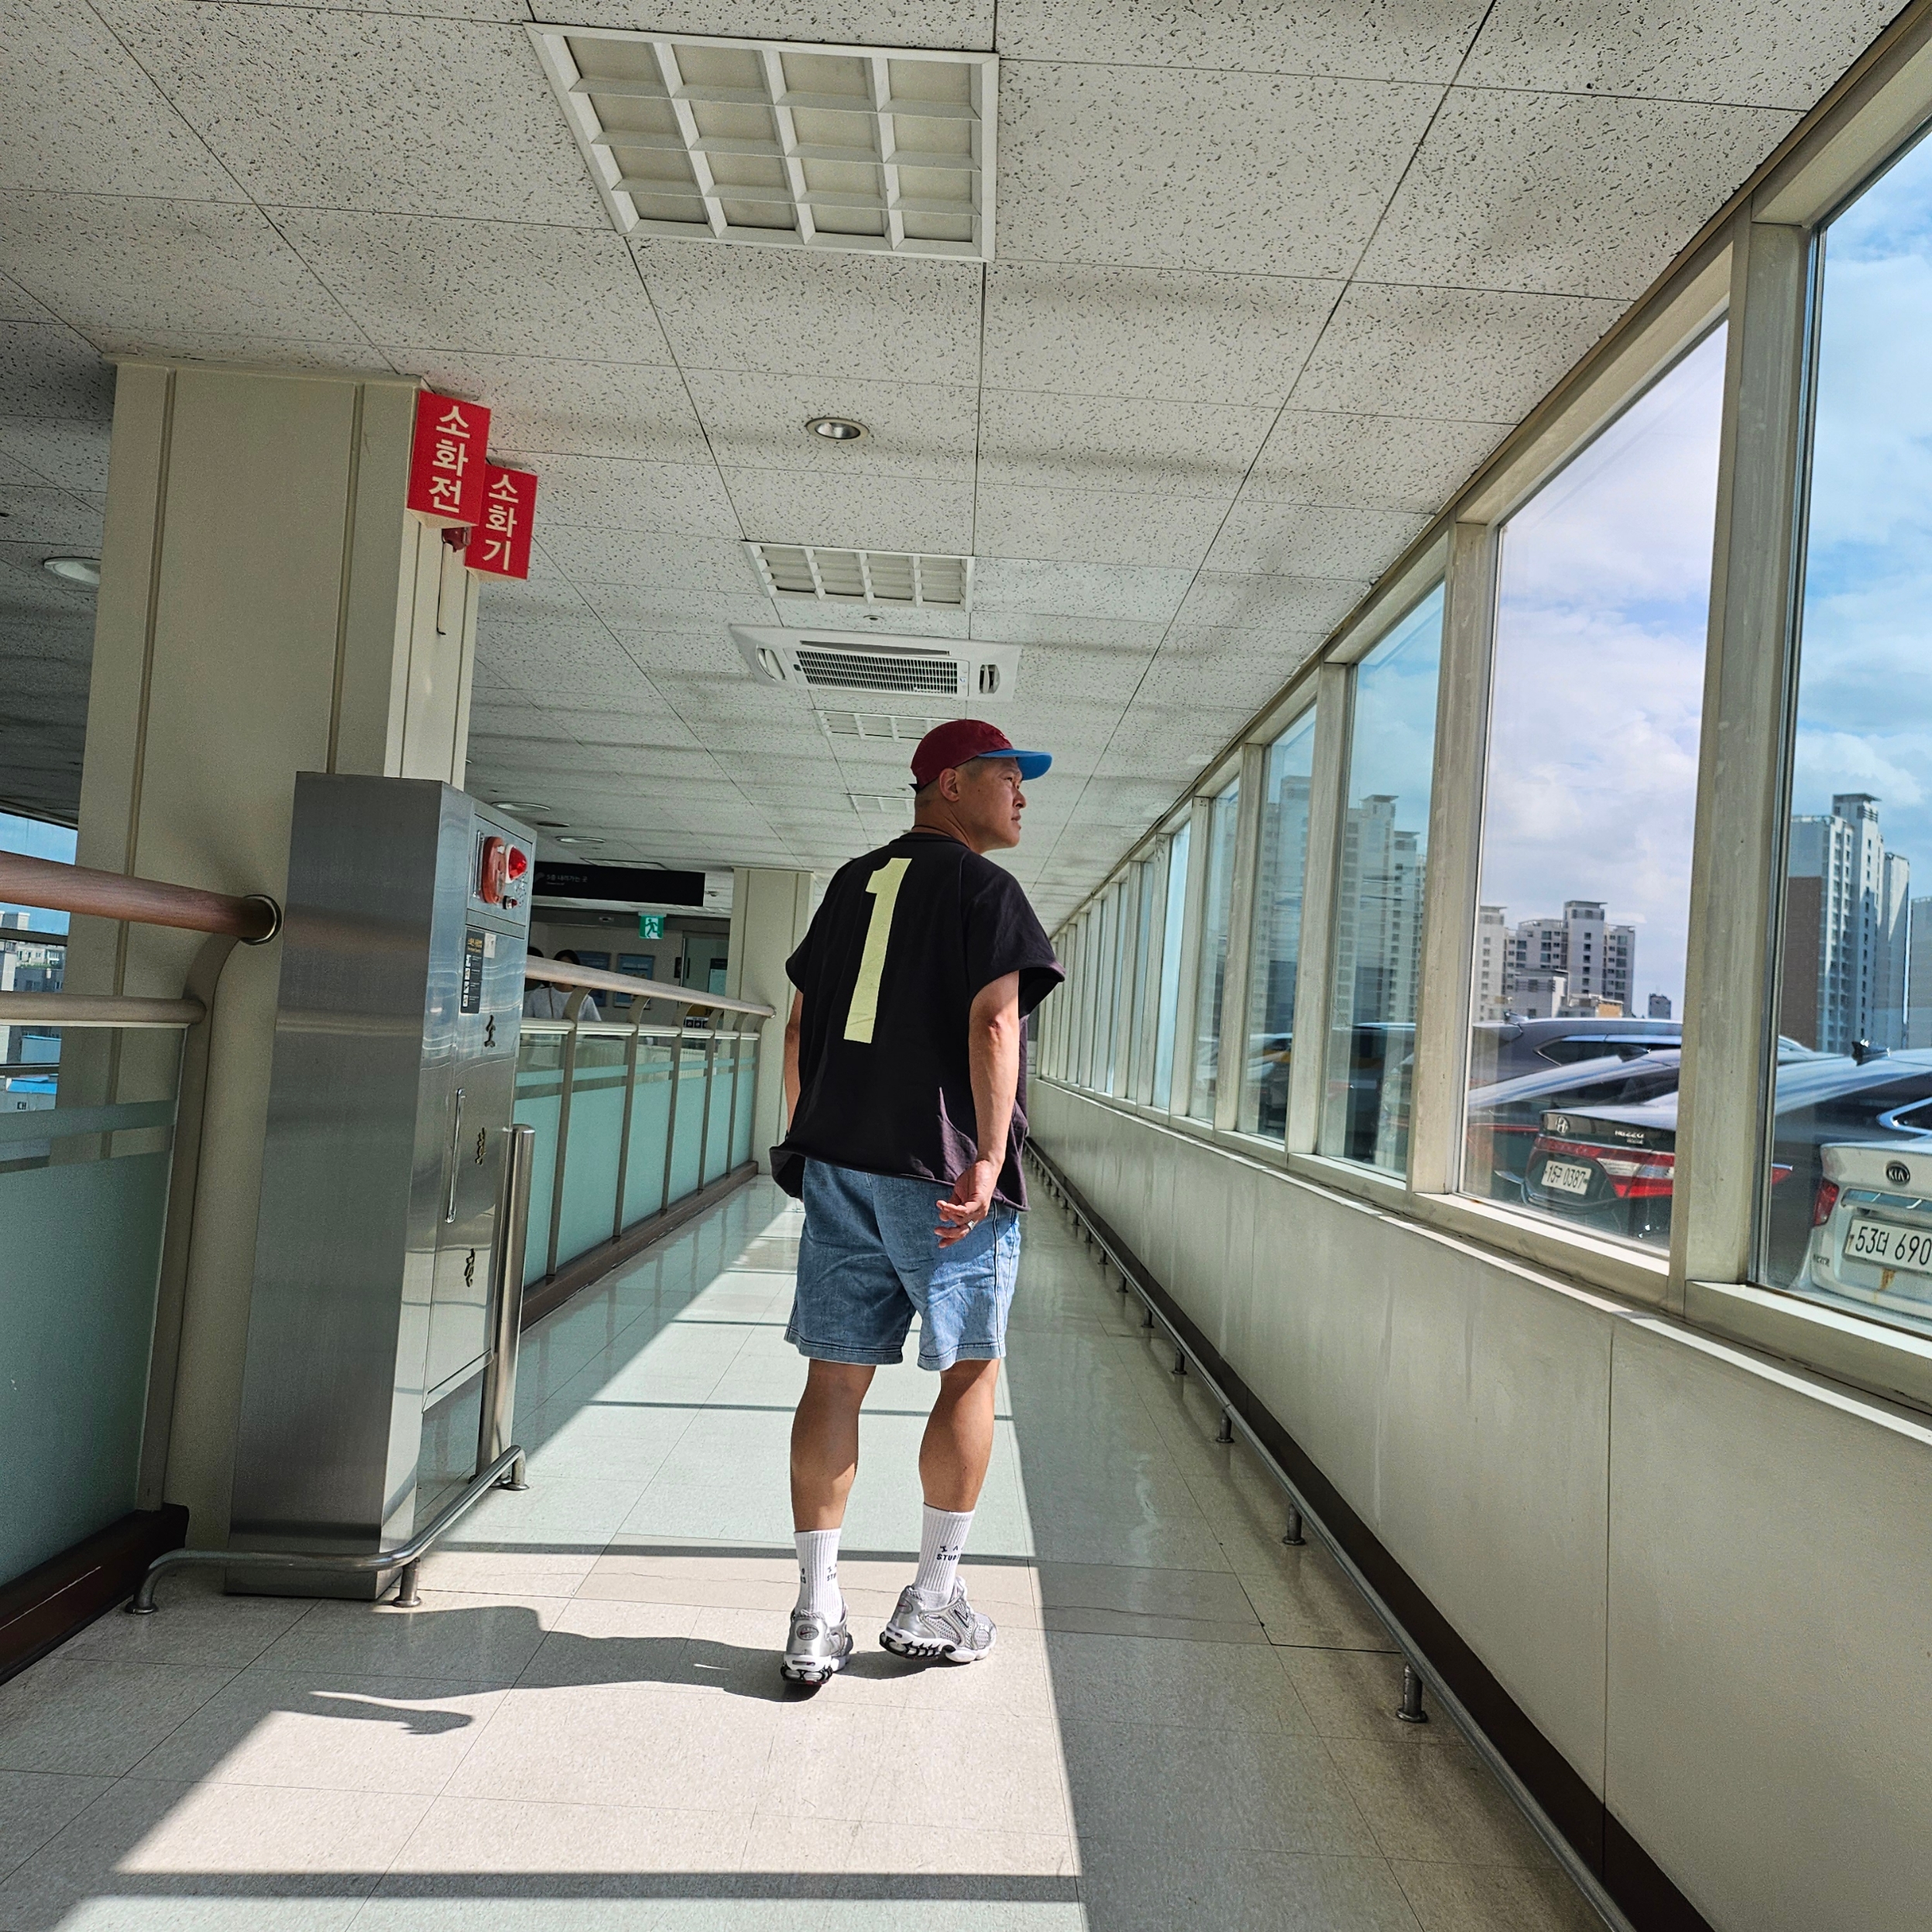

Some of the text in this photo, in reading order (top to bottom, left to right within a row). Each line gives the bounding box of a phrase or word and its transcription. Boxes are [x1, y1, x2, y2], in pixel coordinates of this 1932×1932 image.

[428, 405, 471, 513] 소화전
[482, 474, 520, 571] 소화기
[843, 857, 913, 1044] 1
[1563, 1168, 1586, 1189] 0387
[1889, 1168, 1906, 1182] KIA
[1855, 1226, 1890, 1257] 53더
